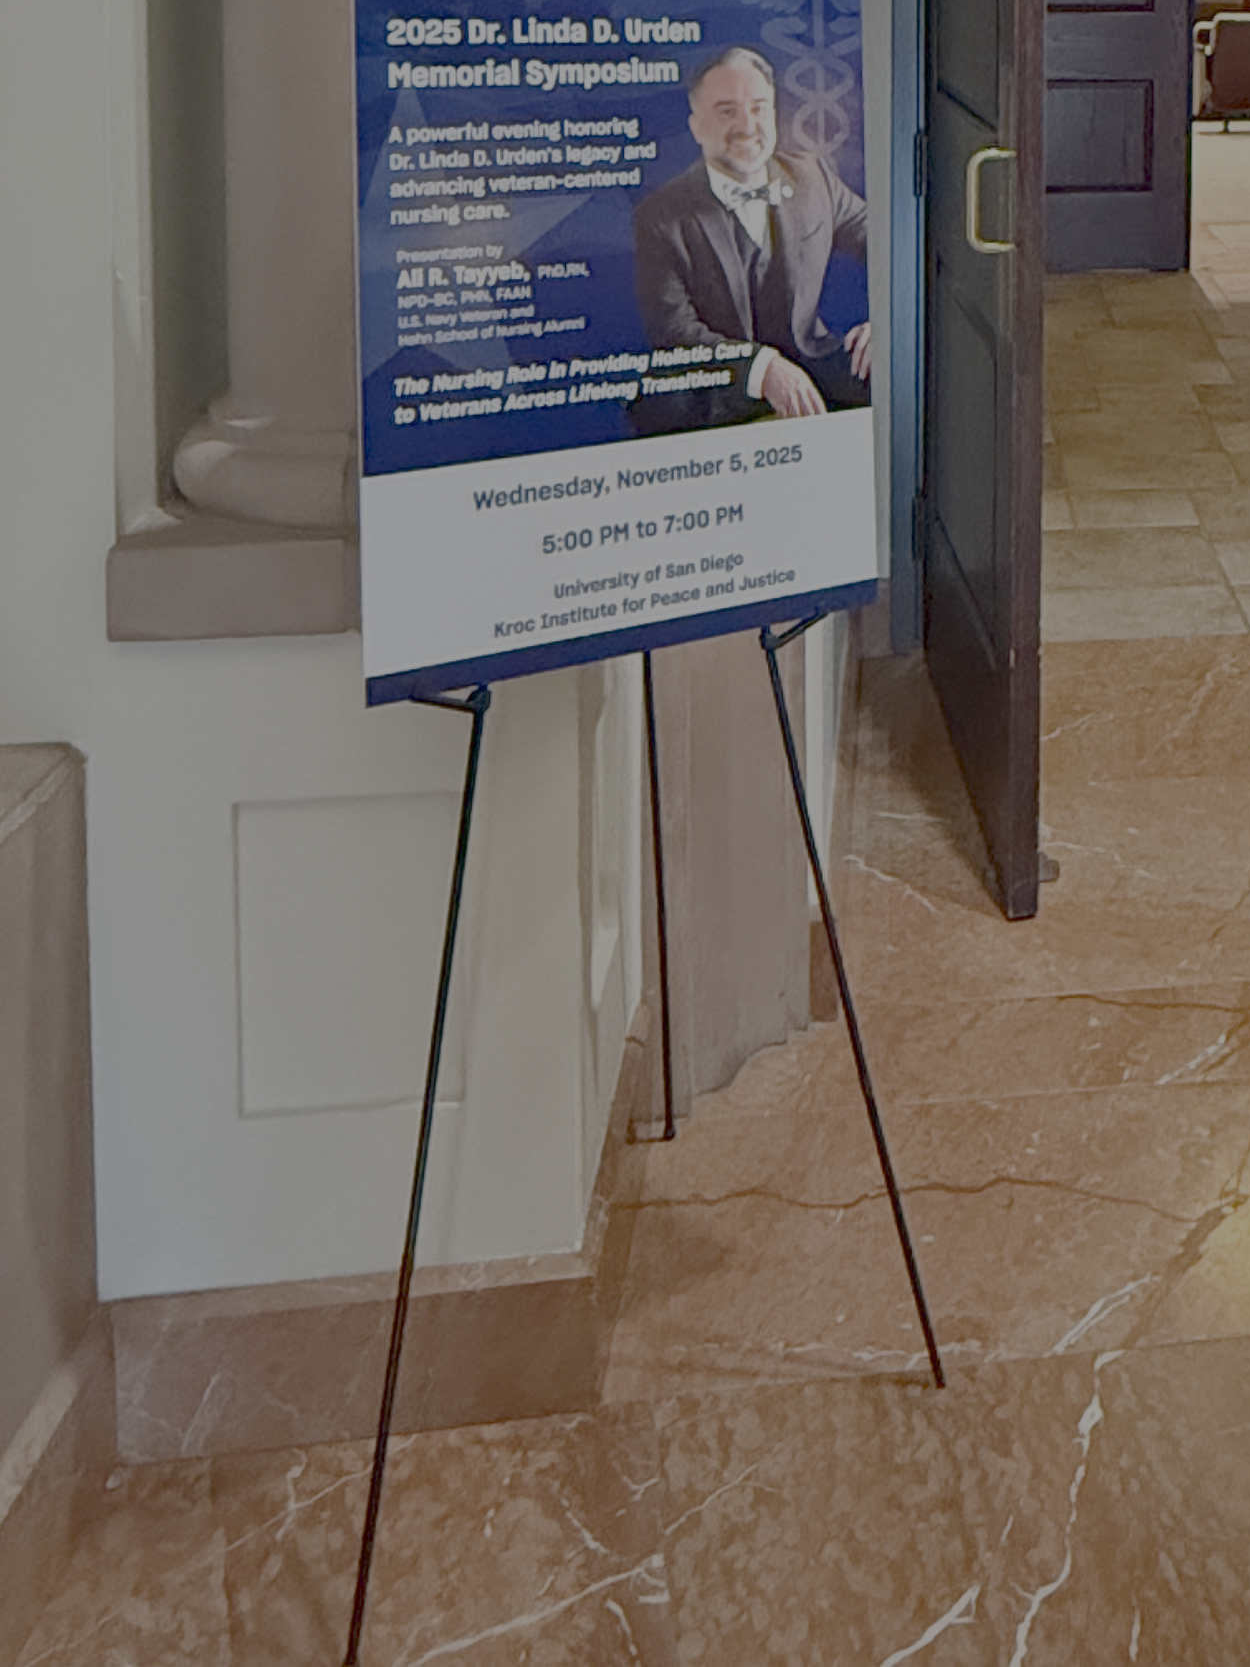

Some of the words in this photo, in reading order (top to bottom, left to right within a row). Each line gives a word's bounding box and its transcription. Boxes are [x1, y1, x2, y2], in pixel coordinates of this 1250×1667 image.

[386, 18, 462, 46] 2025
[468, 18, 507, 45] Dr.
[513, 16, 588, 45] Linda
[593, 18, 620, 44] D.
[625, 16, 701, 44] Urden
[388, 58, 520, 89] Memorial
[525, 56, 680, 92] Symposium
[389, 126, 403, 144] A
[406, 121, 489, 147] powerful
[491, 119, 561, 142] evening
[564, 116, 640, 138] honoring
[389, 153, 415, 171] Dr.
[419, 150, 470, 170] Linda
[474, 149, 492, 168] D.
[496, 146, 563, 166] Urden's
[566, 144, 622, 166] legacy
[623, 141, 657, 161] and
[389, 176, 486, 199] advancing
[488, 167, 641, 194] veteran-centered
[390, 204, 460, 226] nursing
[463, 202, 511, 222] care.
[396, 246, 483, 264] Presentation
[486, 244, 504, 259] by
[396, 267, 425, 290] Ali
[428, 266, 449, 287] R.
[453, 260, 531, 288] Tayyeb,
[398, 315, 424, 330] U.S.
[425, 313, 458, 328] Navy
[459, 308, 508, 323] Veteran
[509, 304, 536, 319] and
[398, 332, 433, 348] Hahn
[434, 327, 478, 344] School
[480, 325, 495, 340] of
[496, 320, 544, 338] Nursing
[544, 316, 586, 332] Alumni
[394, 377, 430, 398] The
[432, 369, 504, 394] Nursing
[506, 363, 547, 386] Role
[549, 360, 566, 380] in
[569, 352, 649, 378] Providing
[652, 345, 713, 369] Holistic
[715, 341, 754, 361] Care
[393, 404, 415, 425] to
[420, 395, 502, 421] Veterans
[503, 387, 566, 412] Across
[569, 380, 638, 406] Lifelong
[642, 368, 731, 395] Transitions
[473, 475, 610, 511] Wednesday,
[617, 456, 724, 490] November
[729, 452, 749, 474] 5,
[753, 444, 803, 469] 2025
[542, 529, 593, 554] 5:00
[600, 522, 630, 546] PM
[636, 519, 658, 539] to
[663, 509, 710, 534] 7:00
[716, 503, 744, 526] PM
[553, 570, 640, 599] University
[644, 565, 662, 582] of
[665, 562, 696, 579] San
[700, 552, 744, 574] Diego
[494, 617, 536, 638] Kroc
[540, 601, 618, 629] Institute
[622, 596, 647, 614] for
[650, 586, 701, 608] Peace
[705, 577, 735, 597] and
[738, 567, 796, 592] Justice
